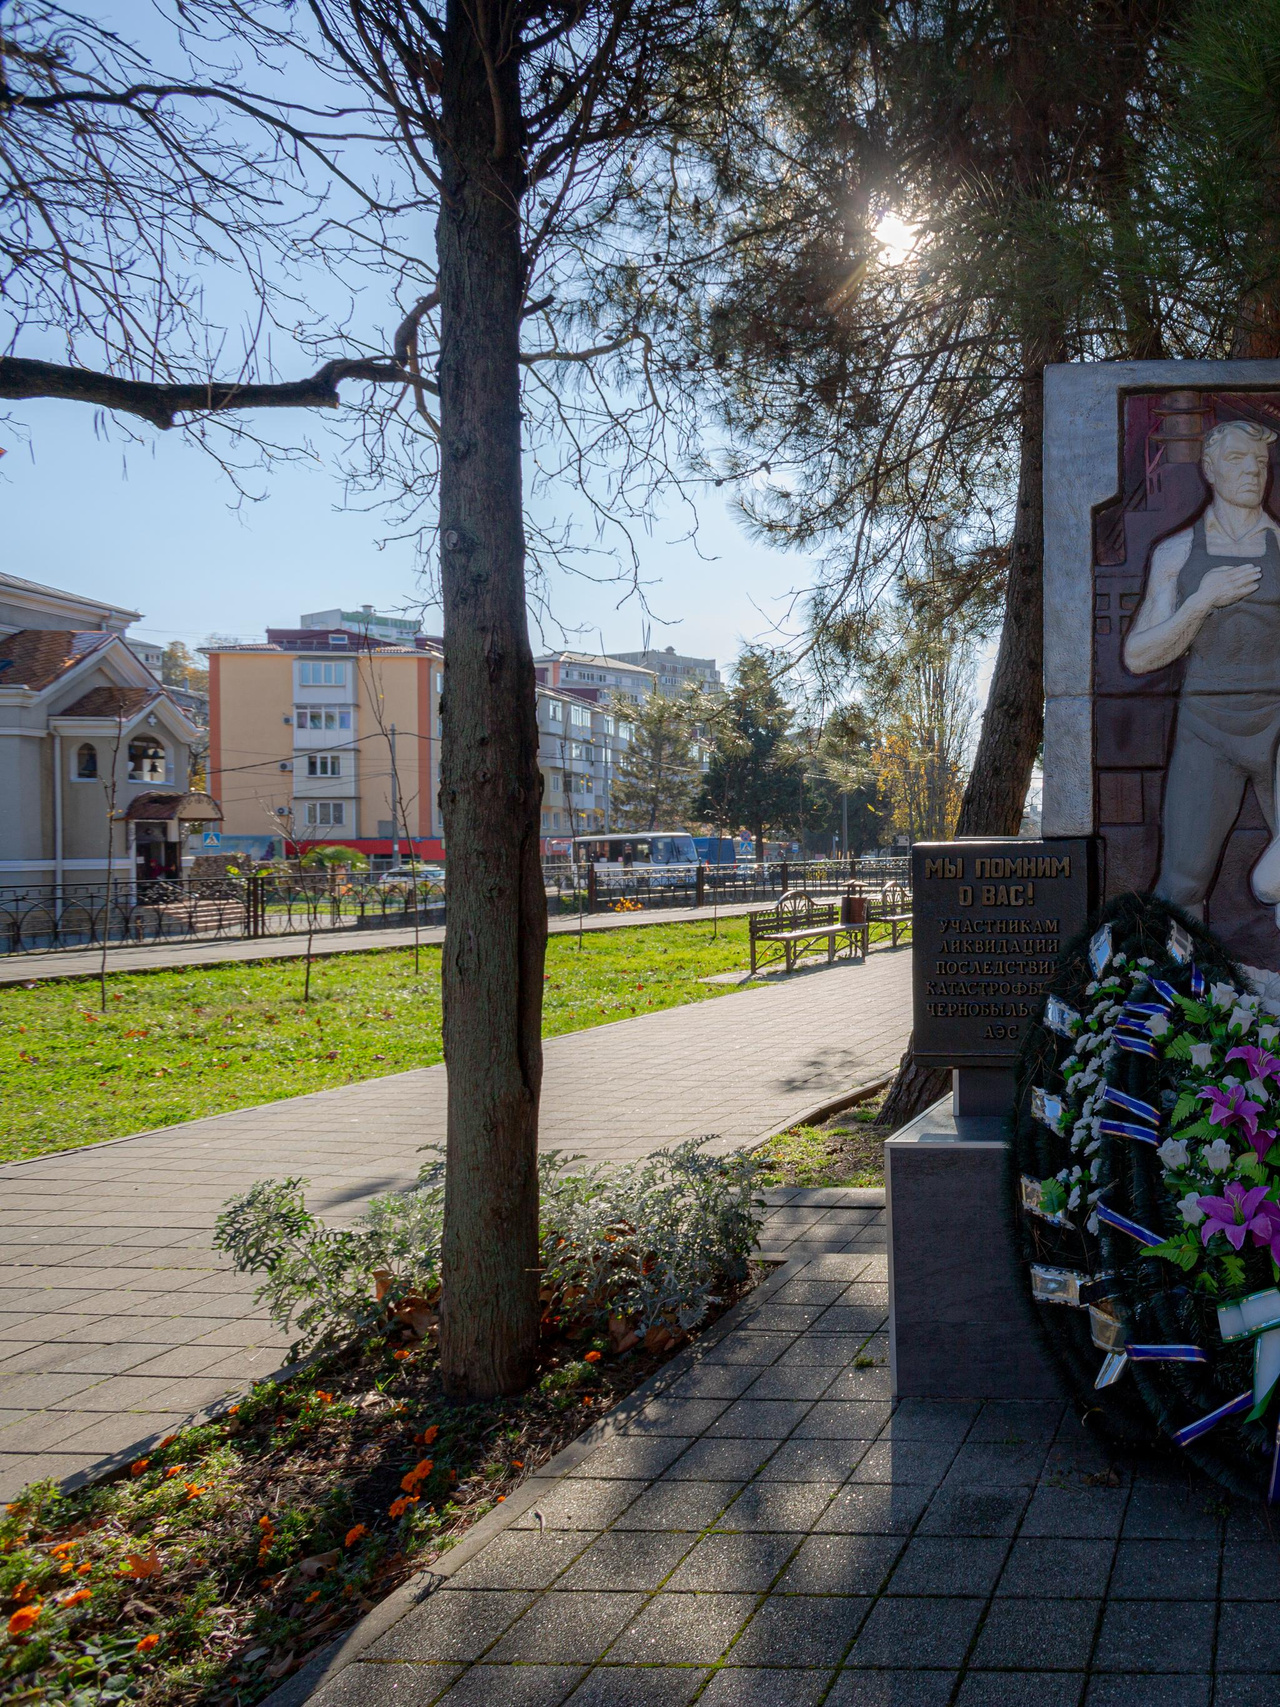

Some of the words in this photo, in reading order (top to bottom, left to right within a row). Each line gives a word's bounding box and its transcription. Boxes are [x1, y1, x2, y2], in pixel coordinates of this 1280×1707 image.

[925, 857, 963, 879] МЫ
[975, 856, 1070, 879] ПОМНИМ
[959, 885, 973, 906] О
[982, 882, 1035, 906] ВАС!
[939, 918, 1059, 934] УЧАСТНИКАМ
[940, 939, 1059, 956] ЛИКВИДАЦИИ
[926, 981, 1045, 996] КАТАСТРОФЫ
[926, 1002, 1038, 1017] ЧЕРНОБЫЛЬС
[983, 1025, 1019, 1040] АЭС
